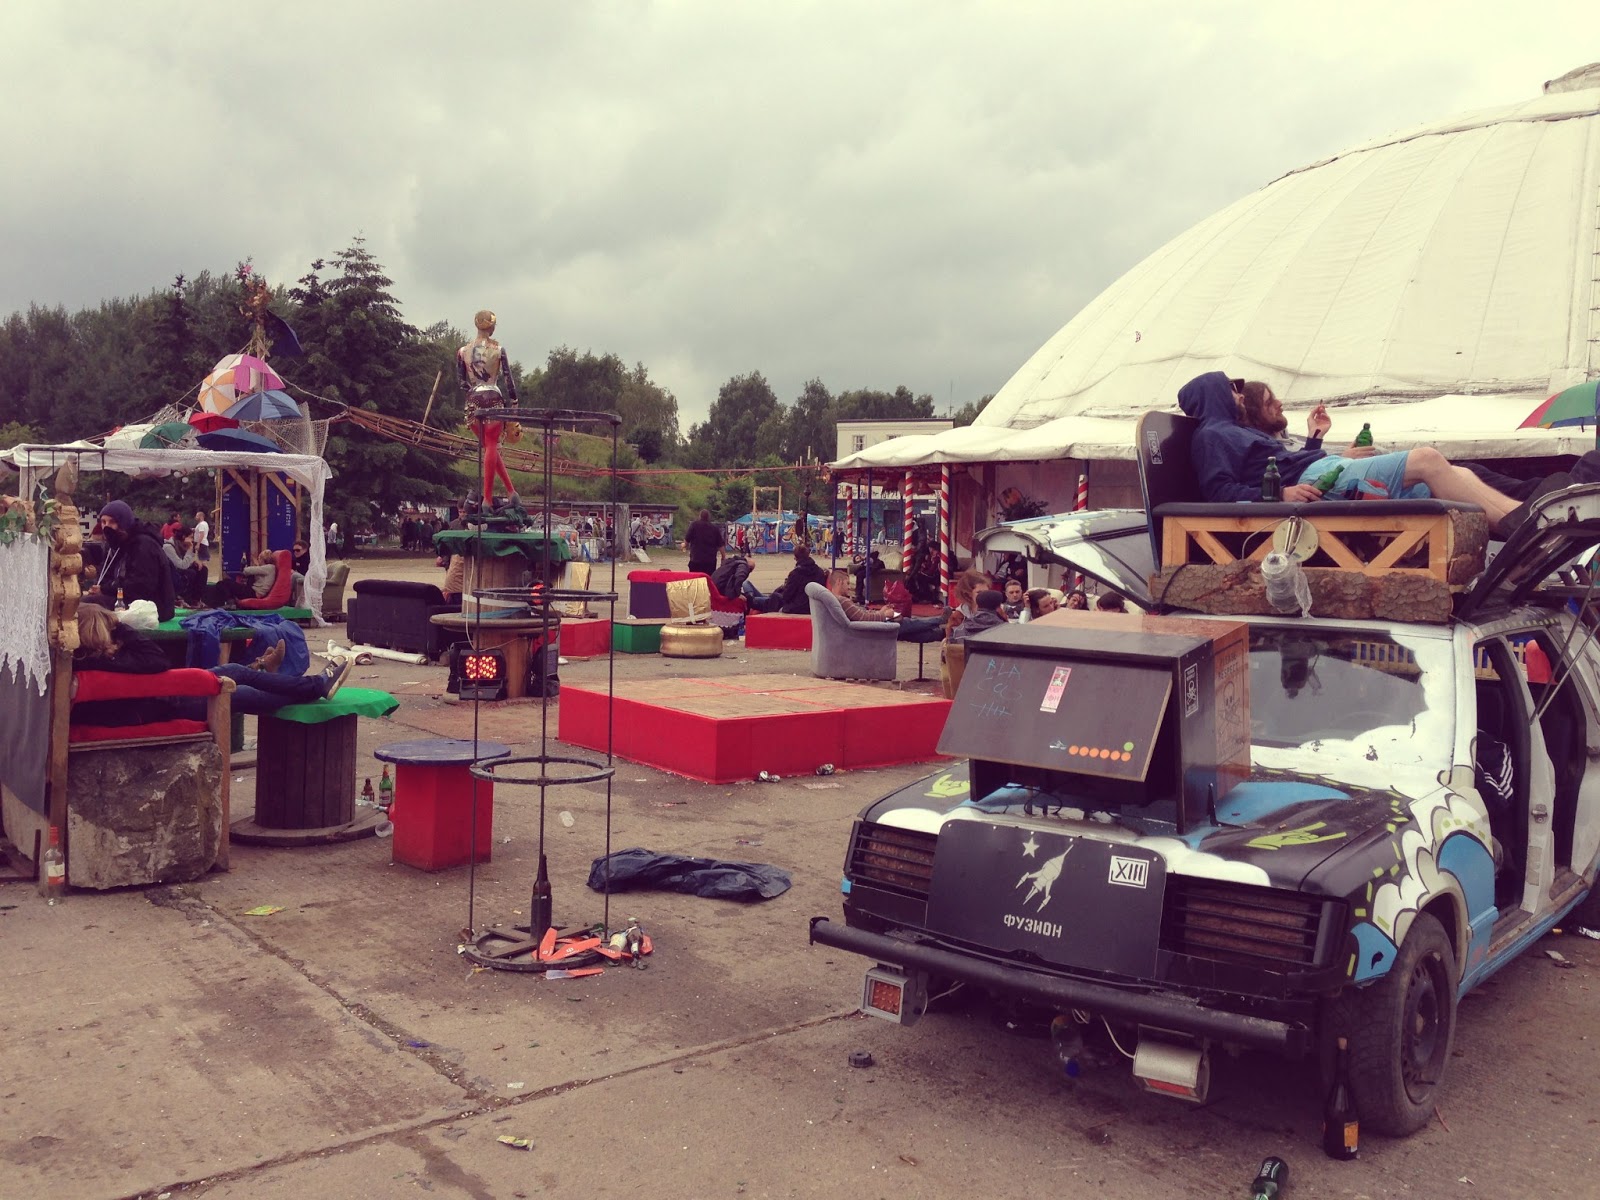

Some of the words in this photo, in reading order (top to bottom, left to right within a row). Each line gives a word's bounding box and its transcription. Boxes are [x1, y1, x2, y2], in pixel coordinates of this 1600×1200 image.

[1218, 661, 1239, 680] RESPECT
[1115, 861, 1144, 882] XIII
[1003, 913, 1063, 938] ФУЗИОН
